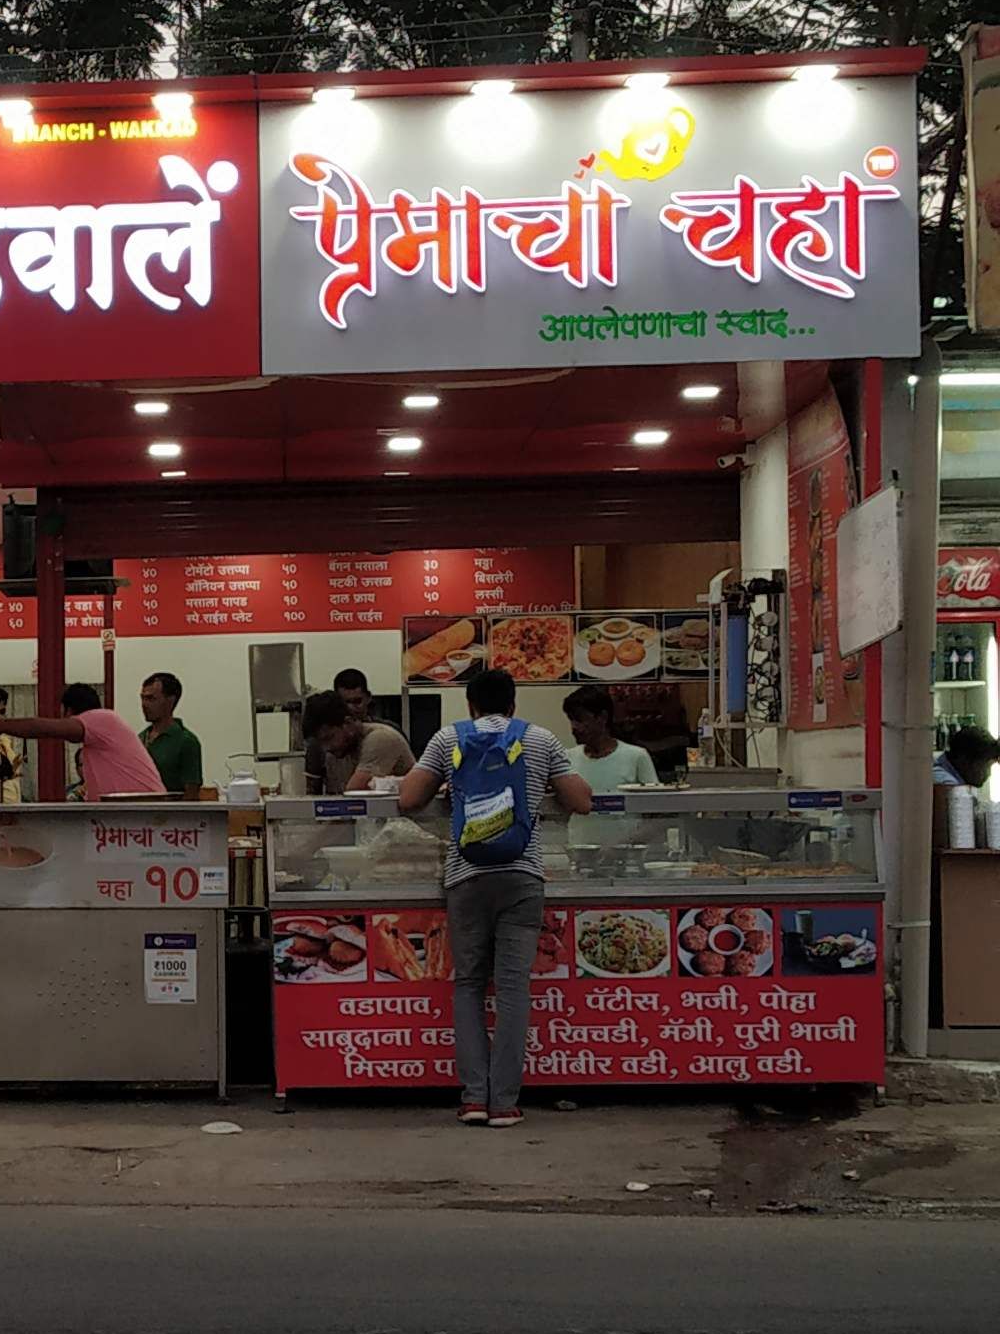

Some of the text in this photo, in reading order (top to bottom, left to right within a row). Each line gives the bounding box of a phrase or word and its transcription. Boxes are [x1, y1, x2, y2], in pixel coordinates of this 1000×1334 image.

[289, 152, 632, 330] प्रेमाचा
[539, 306, 708, 341] आपलेपणाचा
[142, 568, 157, 577] ४०
[282, 564, 297, 574] ५०
[423, 559, 439, 570] ३०
[143, 584, 157, 594] ४०
[282, 580, 297, 589] ५०
[423, 575, 439, 586] ३०
[329, 593, 351, 605] दाल
[424, 592, 439, 601] ५०
[474, 586, 504, 600] लस्सी
[185, 597, 219, 608] मसाला
[283, 611, 306, 621] १००
[329, 609, 354, 623] जिरा
[91, 819, 155, 852] प्रेमाचा
[97, 865, 199, 903] चहा १०
[154, 960, 187, 971] ₹1000
[338, 996, 442, 1019] वडापाव,
[585, 985, 672, 1016] पॅटीस,
[680, 984, 749, 1015] भजी,
[758, 984, 816, 1013] पोहा
[300, 1027, 412, 1054] साबुदाना
[420, 1027, 456, 1047] वड
[548, 1017, 649, 1047] खिचडी,
[659, 1016, 725, 1046] मॅगी,
[734, 1016, 781, 1049] पुरी
[789, 1016, 857, 1043] भाजी
[343, 1052, 426, 1079] मिसळ
[621, 1048, 680, 1078] वडी,
[688, 1054, 752, 1081] आलु
[756, 1047, 813, 1074] वडी.
